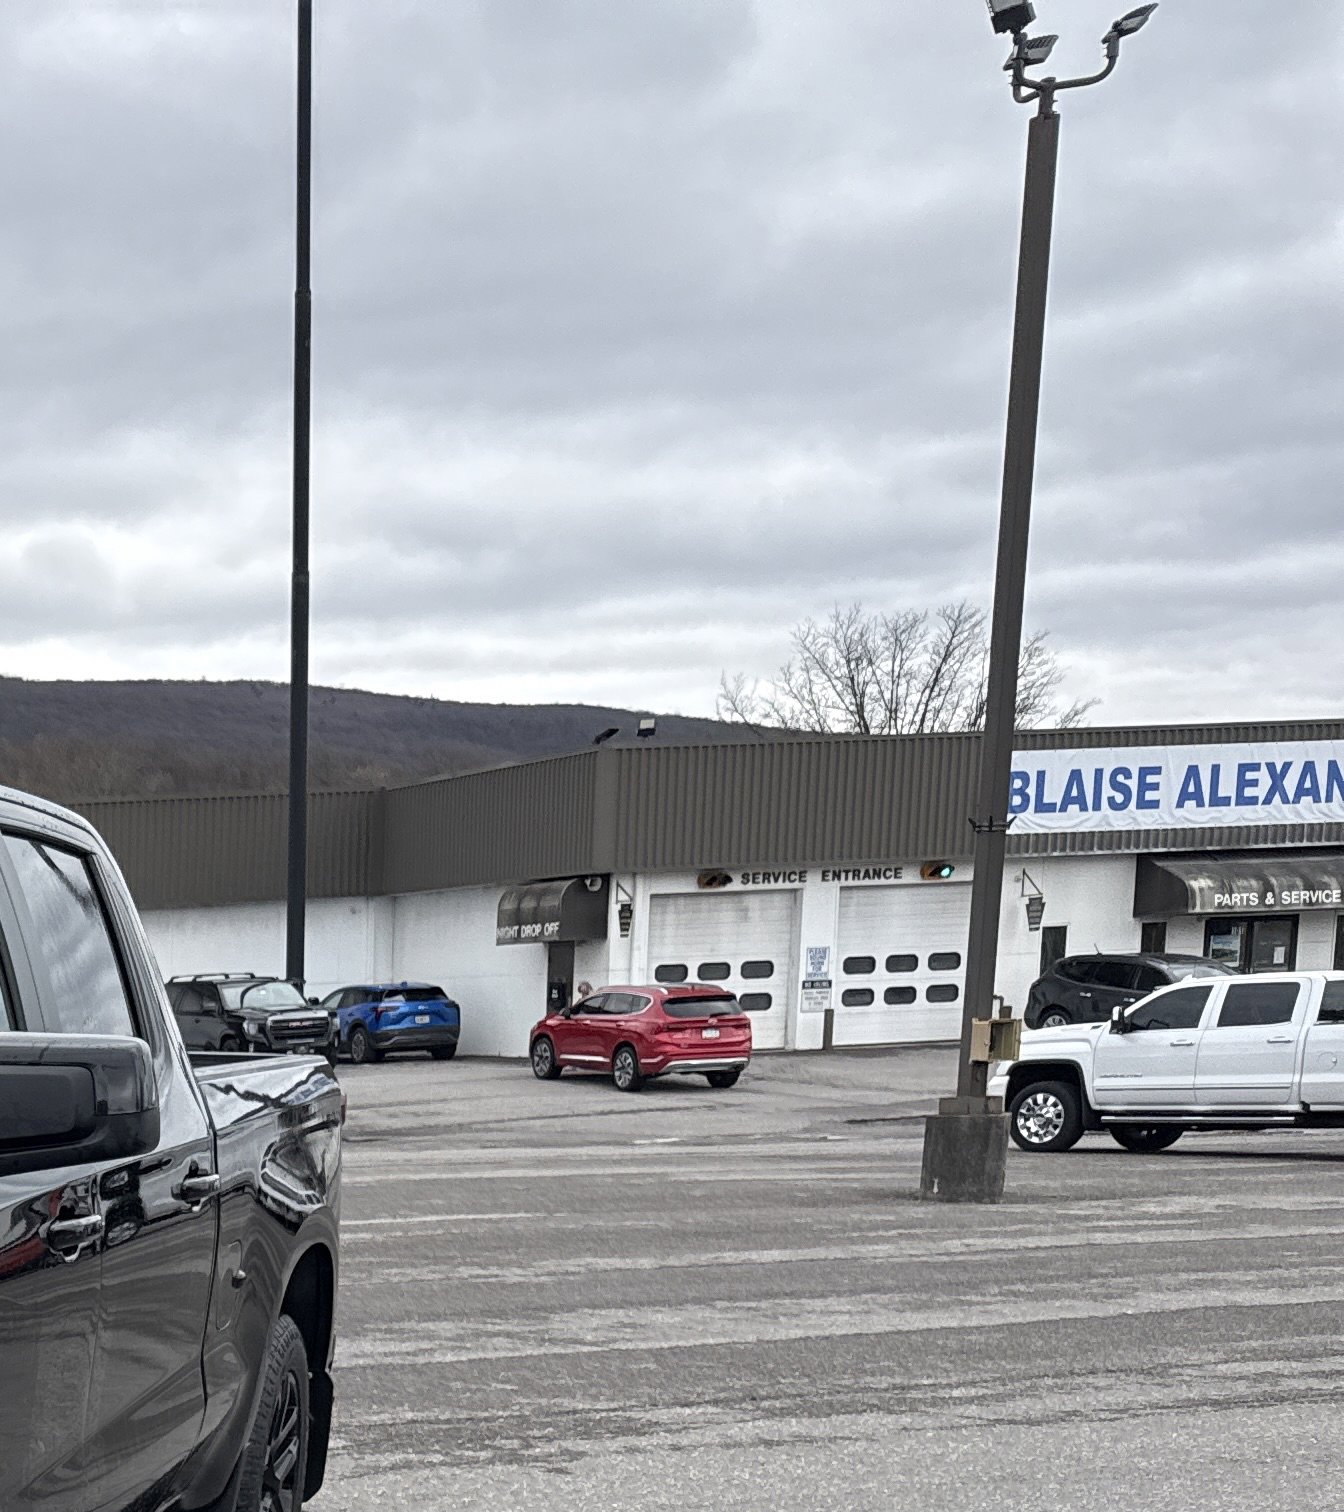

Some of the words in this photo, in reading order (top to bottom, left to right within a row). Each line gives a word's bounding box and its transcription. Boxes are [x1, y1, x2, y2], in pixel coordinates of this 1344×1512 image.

[1010, 765, 1162, 815] BLAISE
[740, 870, 808, 885] SERVICE
[821, 867, 903, 882] ENTRANCE
[1214, 892, 1259, 906] PARTS
[1265, 891, 1275, 905] &
[1281, 889, 1342, 905] SERVICE
[496, 925, 519, 938] NIGHT
[520, 923, 542, 937] DROP
[544, 921, 560, 936] OFF
